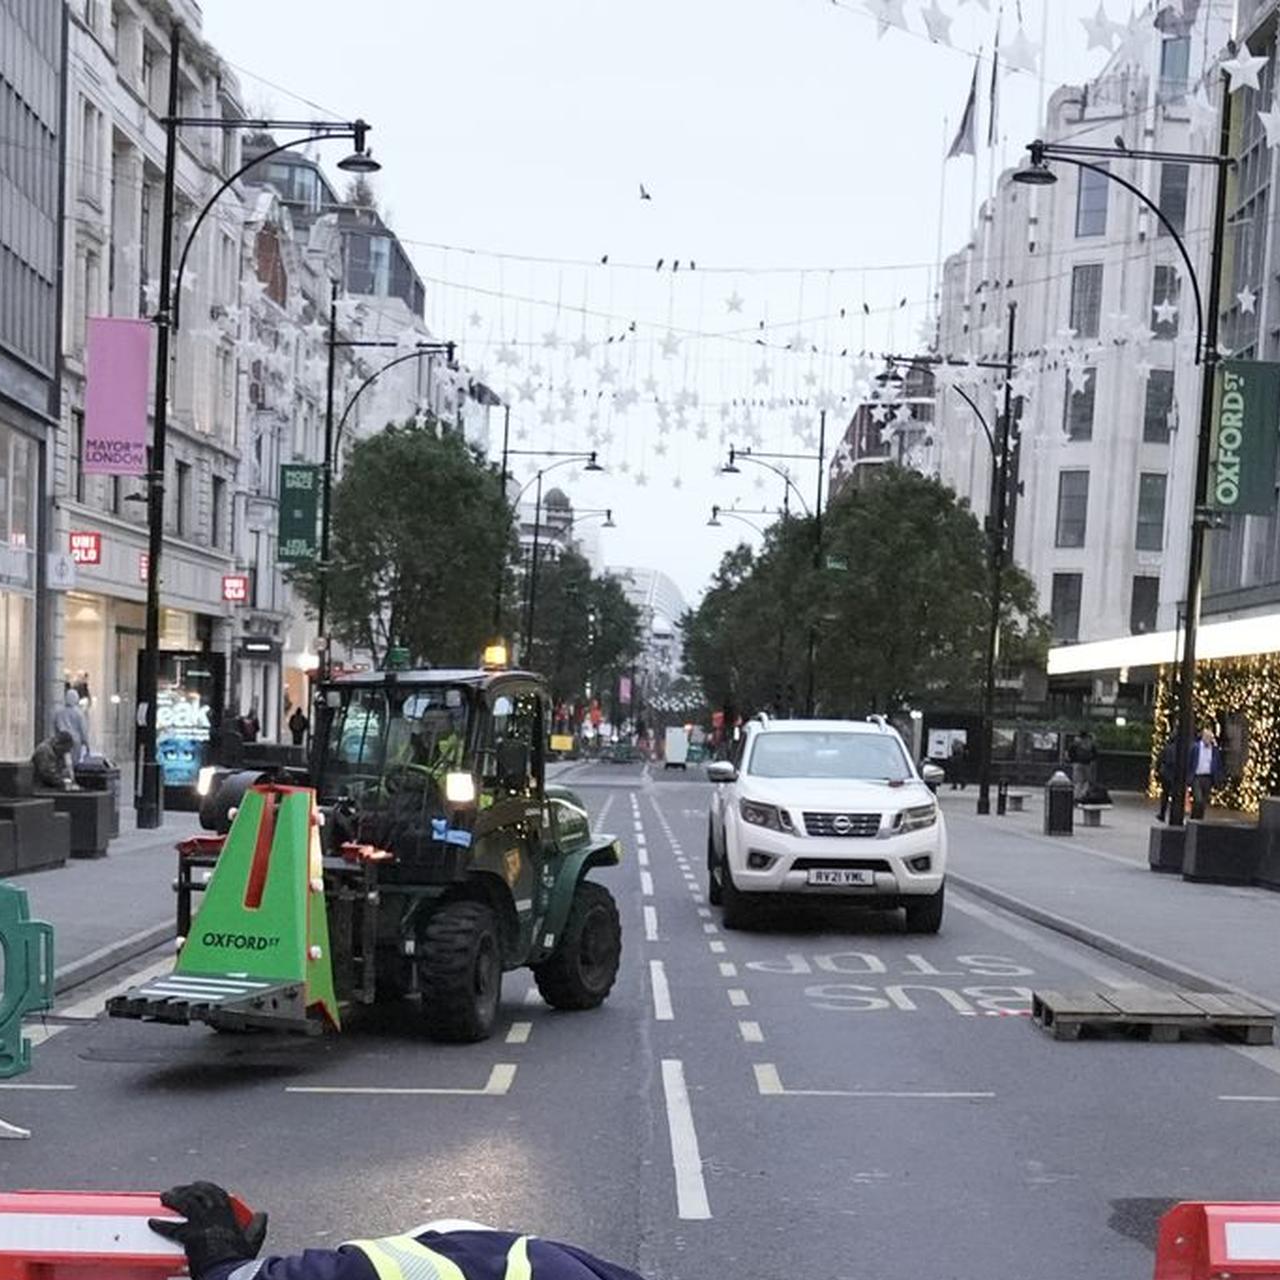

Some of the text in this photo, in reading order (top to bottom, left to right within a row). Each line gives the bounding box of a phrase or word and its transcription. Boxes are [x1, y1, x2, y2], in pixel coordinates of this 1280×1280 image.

[86, 440, 130, 452] MAYOR
[1216, 391, 1245, 505] OXFORD
[85, 452, 143, 464] LONDON
[203, 932, 267, 950] OXFORD
[745, 951, 1035, 976] STOP
[804, 984, 1033, 1012] BUS
